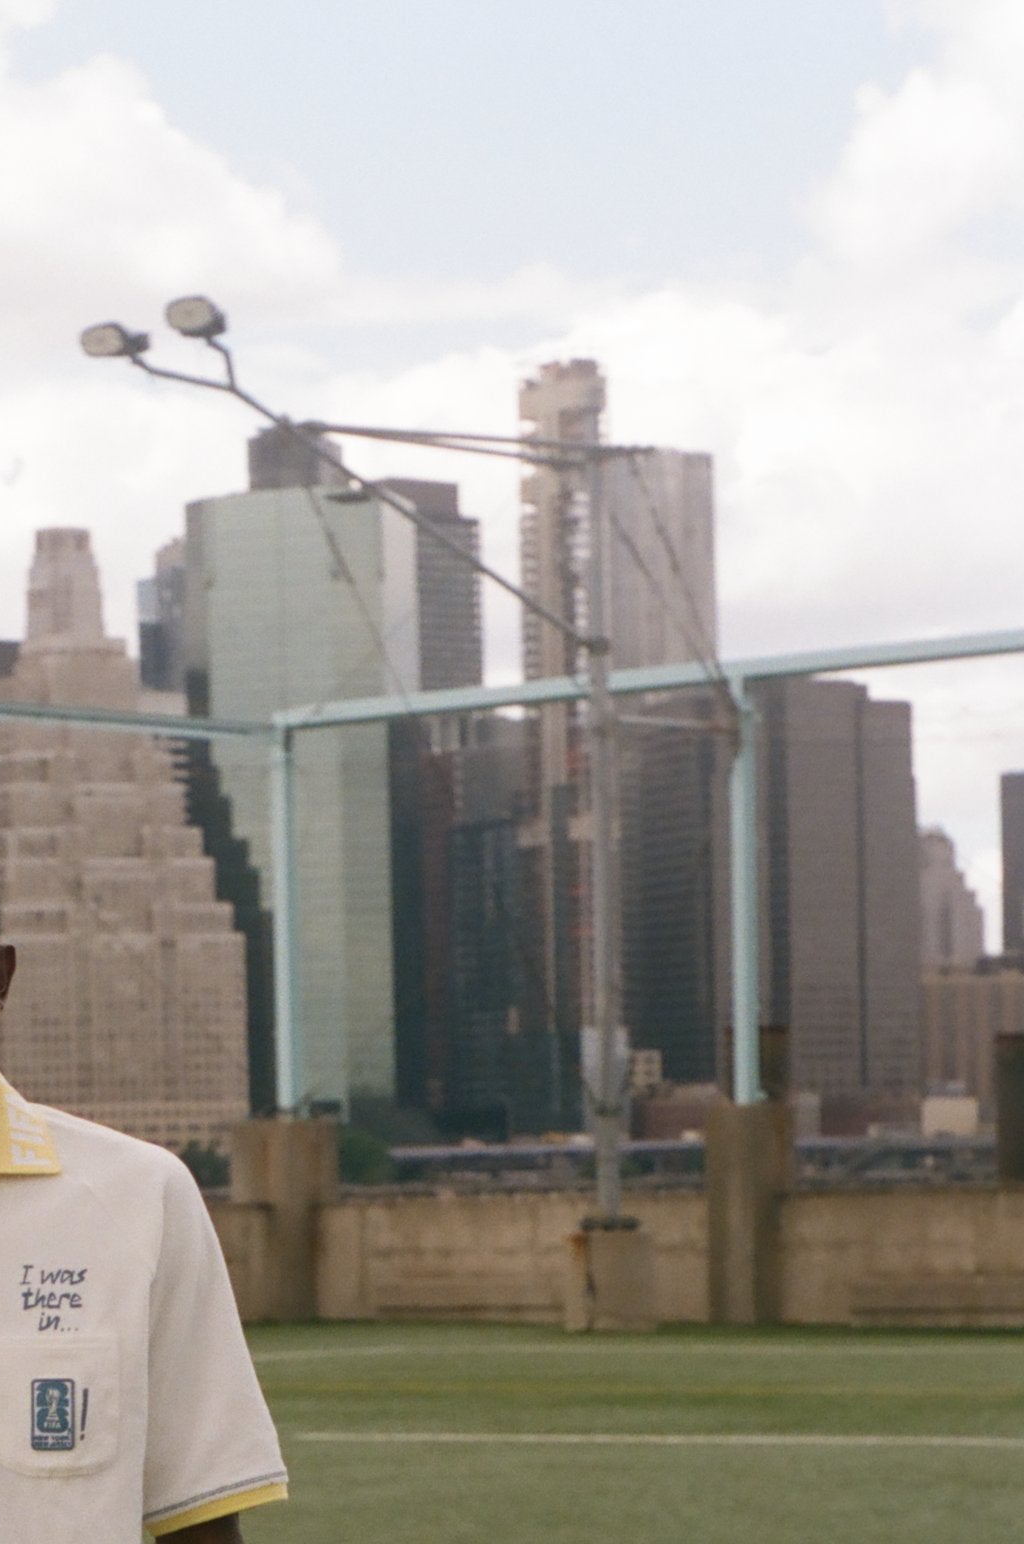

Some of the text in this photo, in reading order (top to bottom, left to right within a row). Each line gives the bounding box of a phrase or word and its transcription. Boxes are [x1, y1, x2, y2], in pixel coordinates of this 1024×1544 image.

[19, 1265, 88, 1286] I was
[21, 1287, 83, 1311] there
[38, 1312, 79, 1332] in...
[43, 1420, 62, 1429] FIFA
